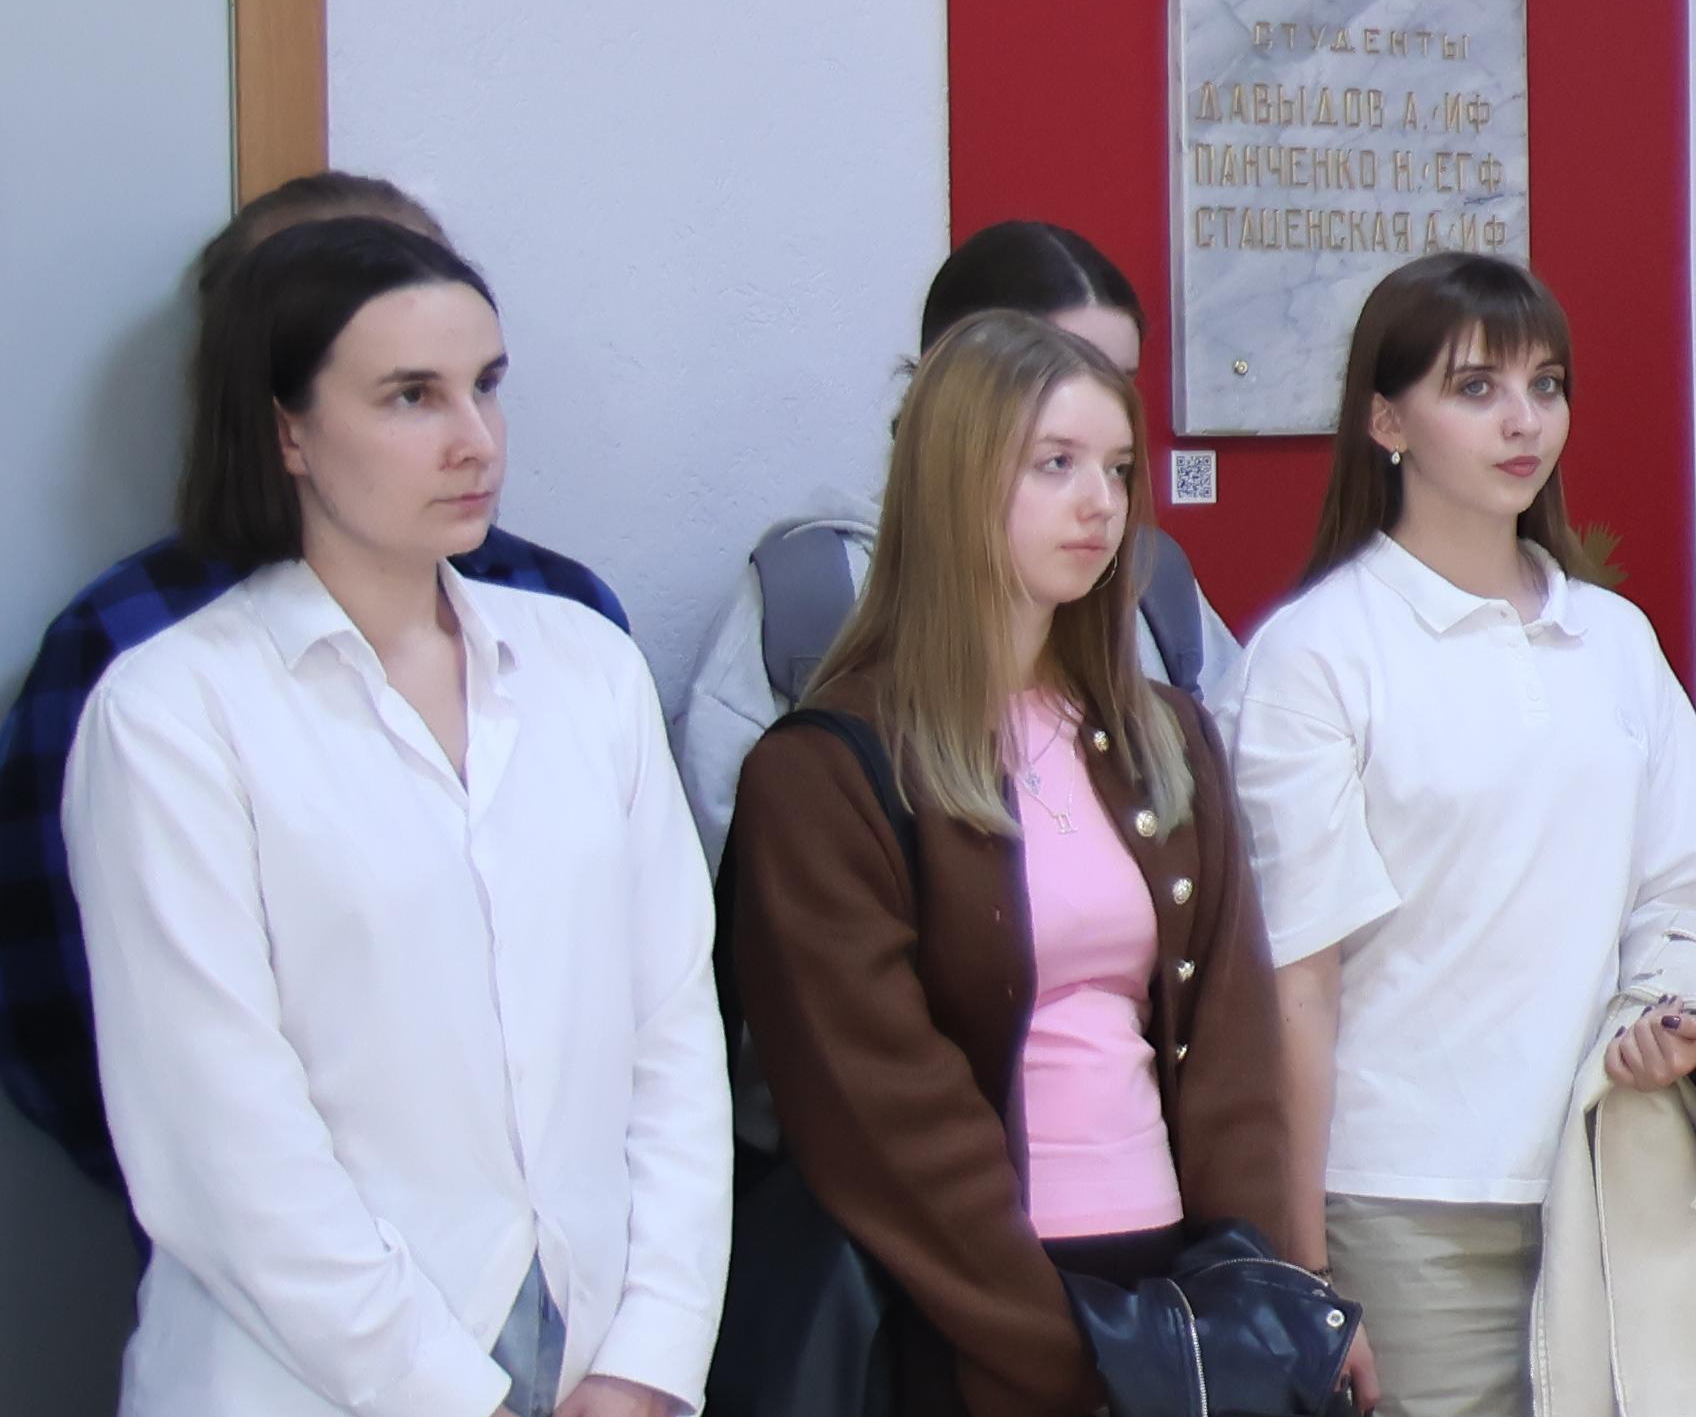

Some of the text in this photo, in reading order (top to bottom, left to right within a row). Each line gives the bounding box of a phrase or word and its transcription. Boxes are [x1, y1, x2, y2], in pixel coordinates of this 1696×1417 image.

[1253, 21, 1470, 60] СТУДЕНТЫ
[1195, 81, 1384, 129] ДАВЫДОВ
[1195, 143, 1376, 190] ПАНЧЕНКО
